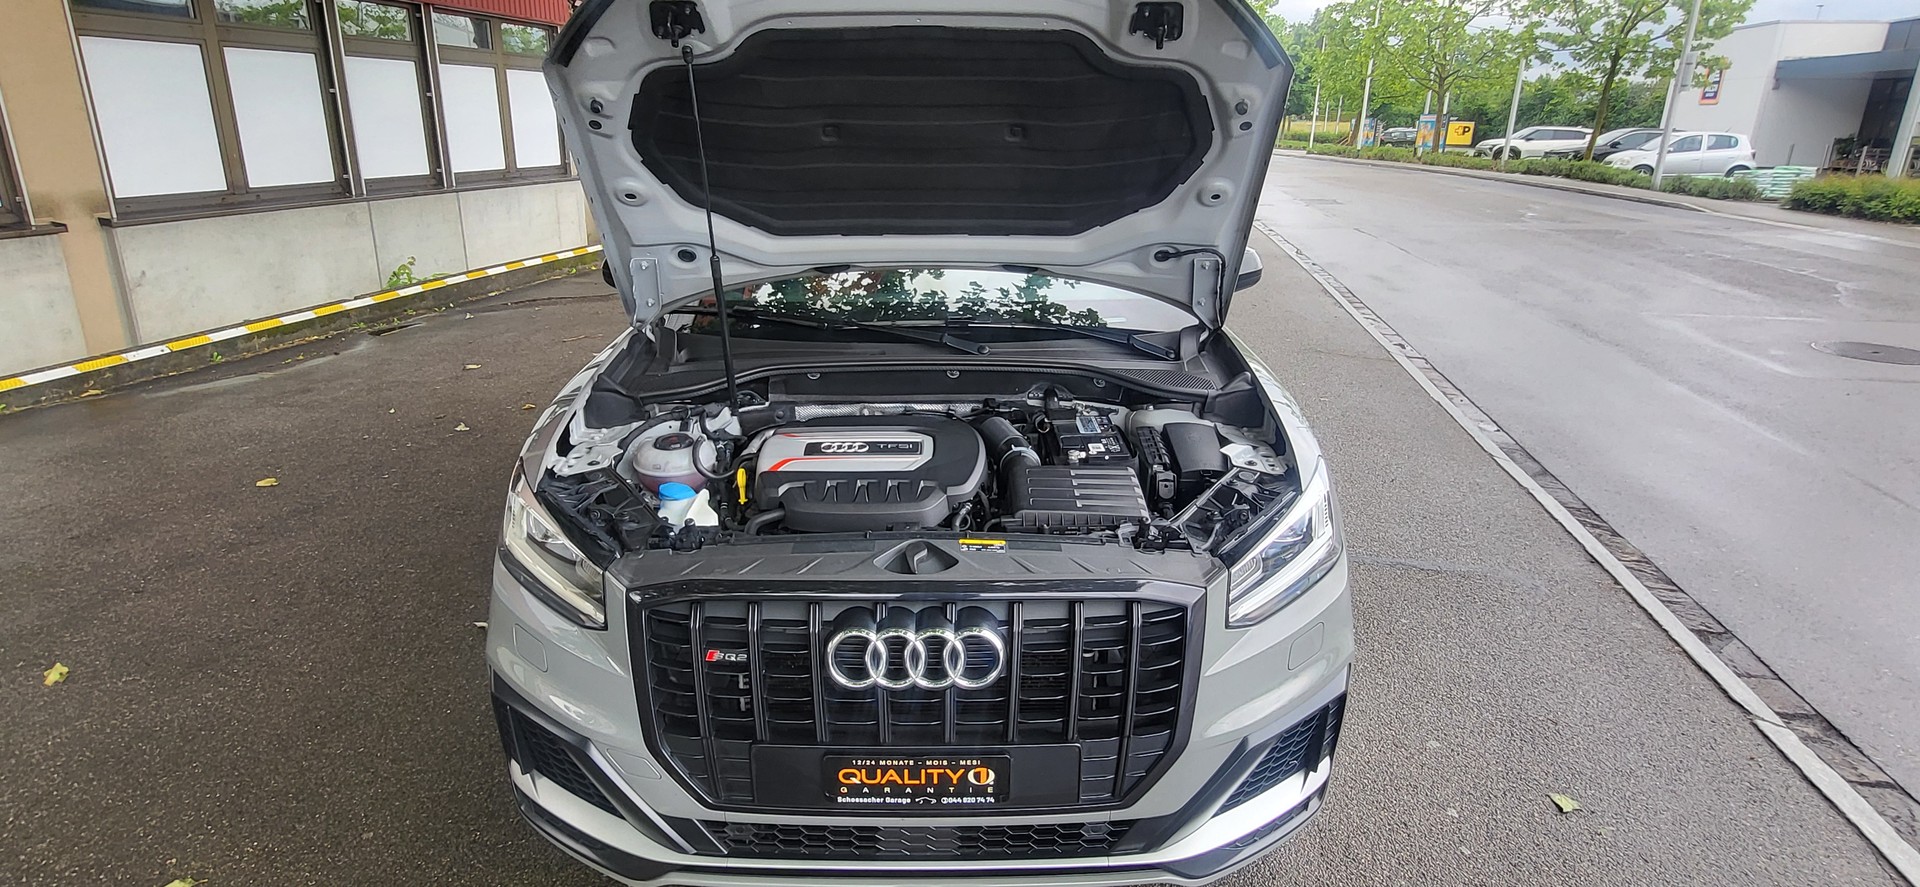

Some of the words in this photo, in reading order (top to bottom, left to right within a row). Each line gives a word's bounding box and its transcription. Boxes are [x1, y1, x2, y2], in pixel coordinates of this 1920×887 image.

[712, 651, 748, 662] SQ2
[838, 768, 966, 785] QUALITY
[840, 786, 994, 794] GARANTIE
[885, 796, 911, 805] Garage
